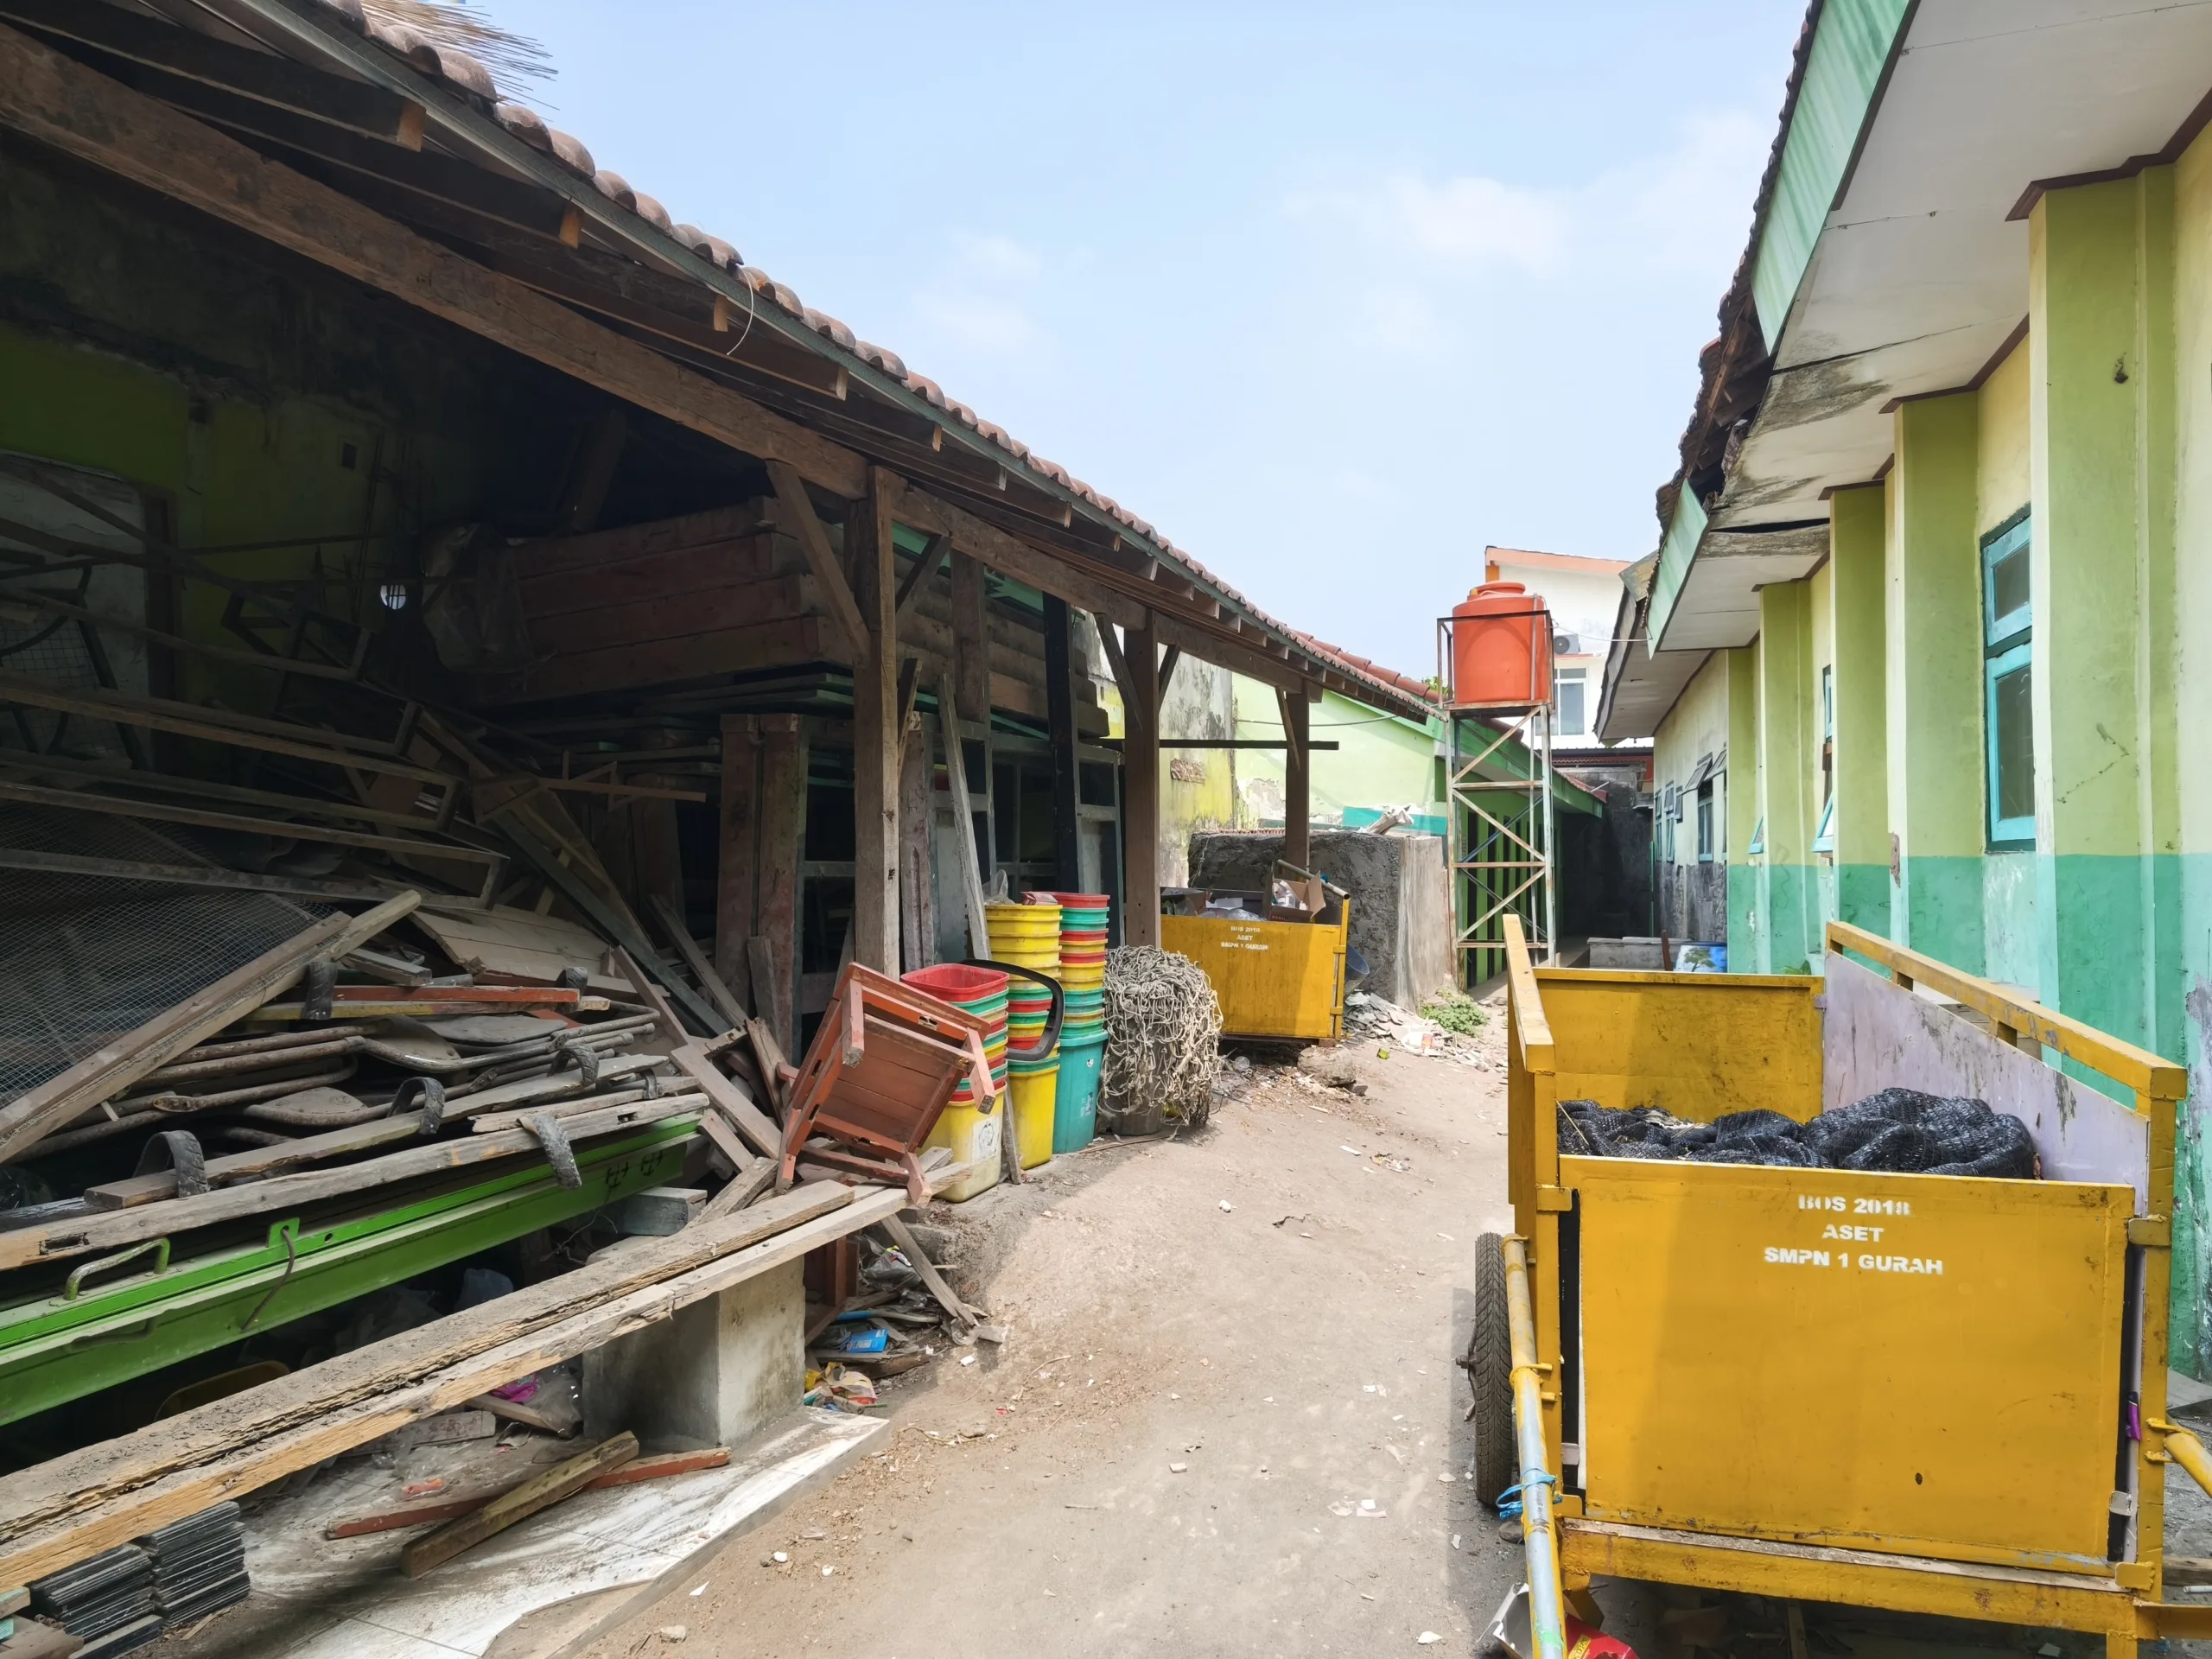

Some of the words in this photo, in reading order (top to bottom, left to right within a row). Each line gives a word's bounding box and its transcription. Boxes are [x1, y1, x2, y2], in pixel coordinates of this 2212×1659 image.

[1797, 1195, 1847, 1212] BOS
[1853, 1198, 1911, 1216] 2018
[1822, 1224, 1885, 1243] ASET
[1764, 1246, 1830, 1267] SMPN
[1837, 1252, 1849, 1268] 1
[1858, 1254, 1943, 1275] GURAH
